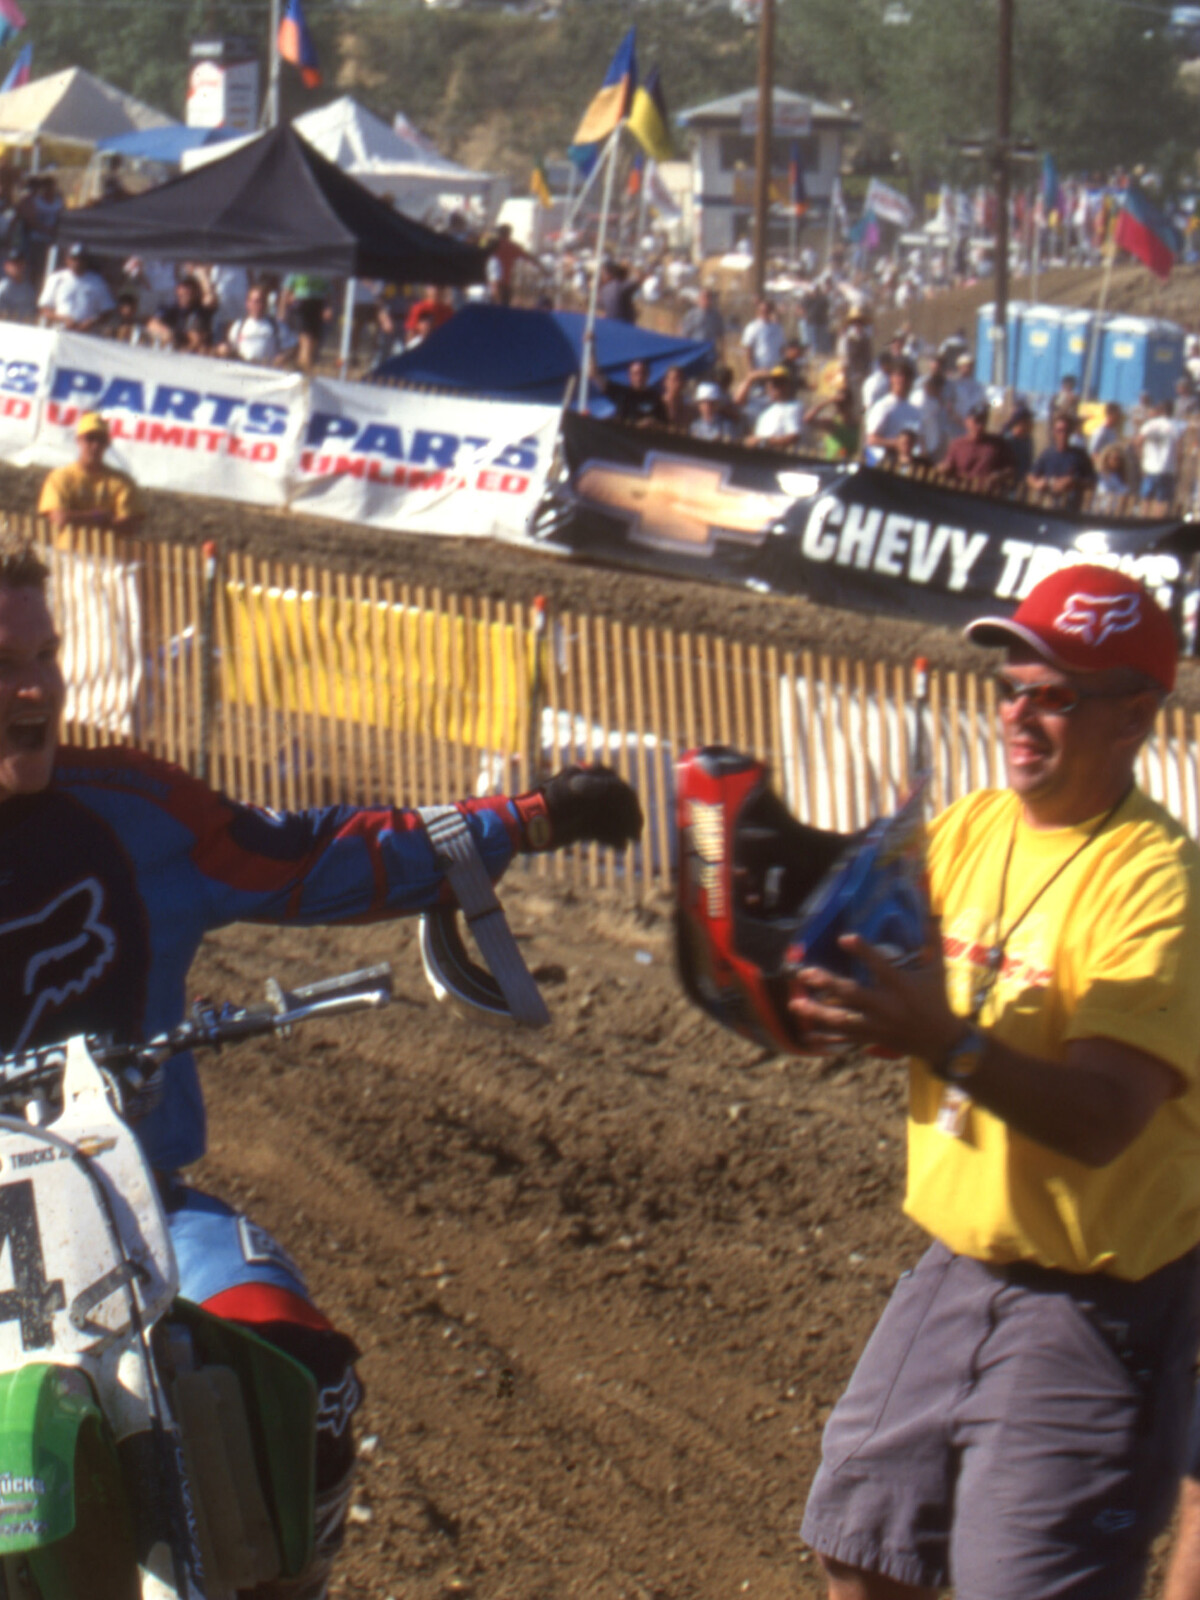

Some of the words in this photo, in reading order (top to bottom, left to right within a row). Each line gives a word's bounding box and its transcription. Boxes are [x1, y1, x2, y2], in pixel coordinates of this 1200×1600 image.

[46, 399, 278, 463] ULIMITED
[49, 368, 289, 435] PARTS
[801, 496, 989, 592] CHEVY
[10, 1146, 55, 1170] TRUCKS
